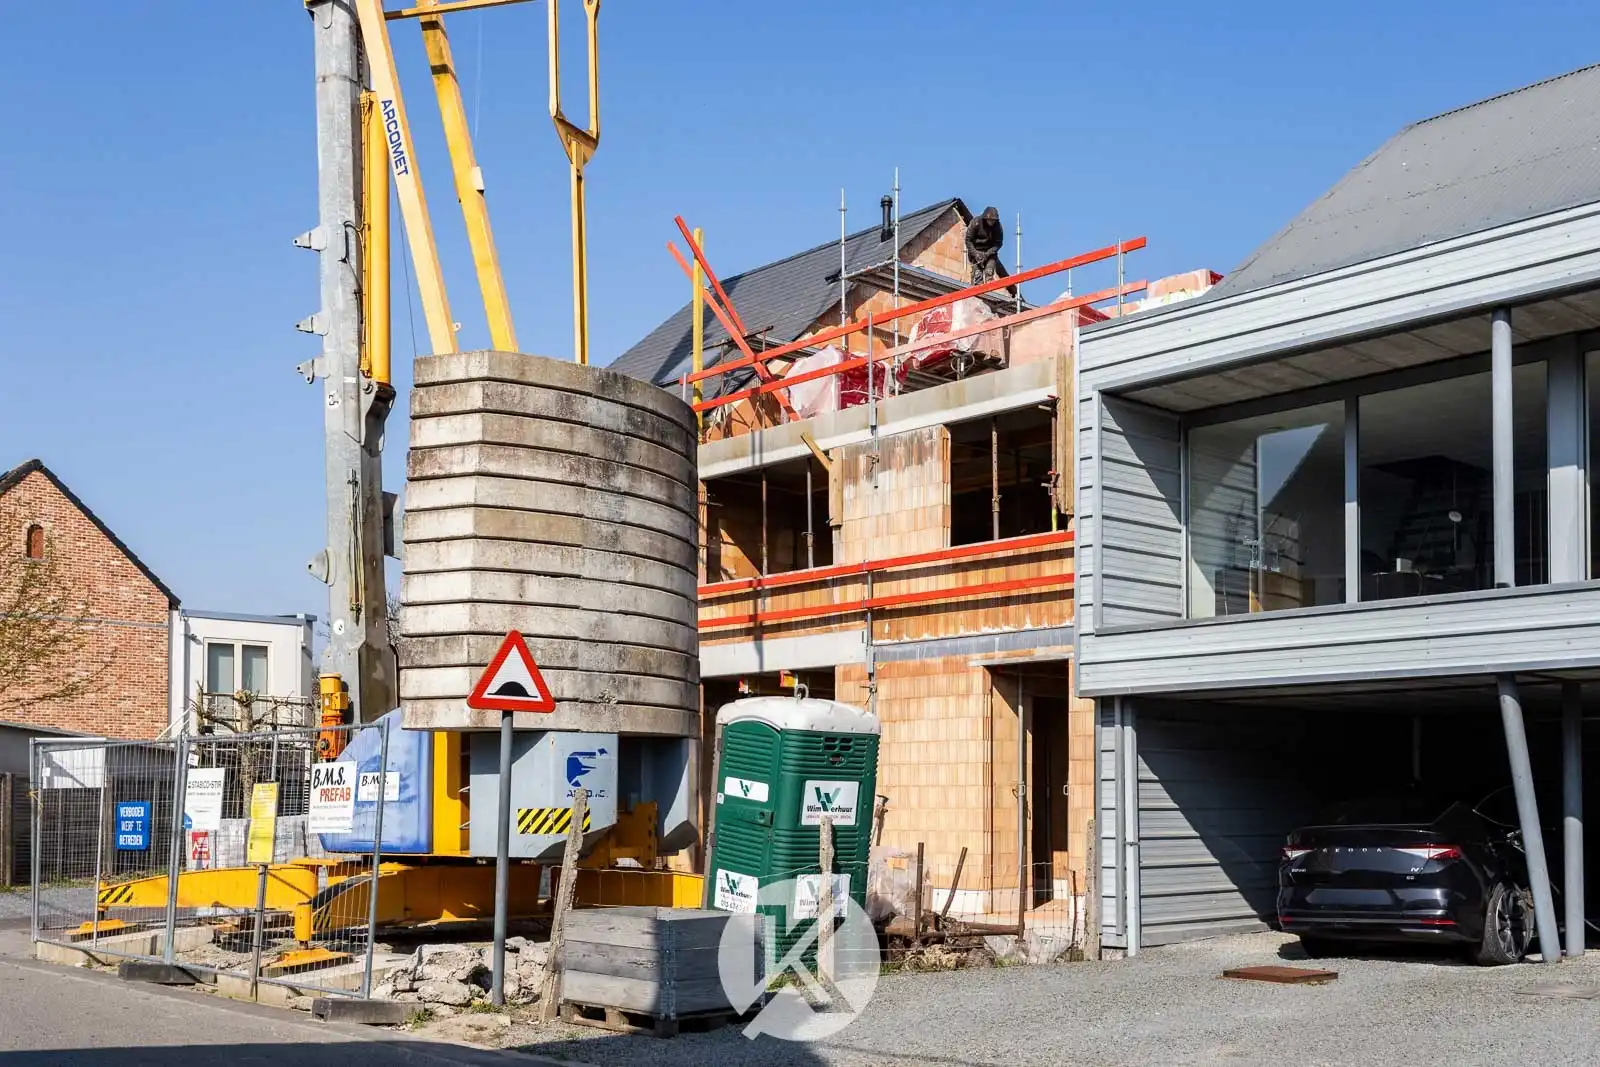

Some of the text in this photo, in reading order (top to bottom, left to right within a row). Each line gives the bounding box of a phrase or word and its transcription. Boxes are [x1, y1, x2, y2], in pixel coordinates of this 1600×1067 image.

[381, 99, 409, 176] ARCOMET
[313, 766, 346, 790] B.M.S.
[361, 775, 389, 787] B.M.
[319, 786, 351, 803] PREFAB
[119, 806, 145, 818] VERBODEN
[806, 804, 822, 812] Wim
[120, 820, 143, 832] WERF TE
[119, 834, 143, 846] BETREDEN
